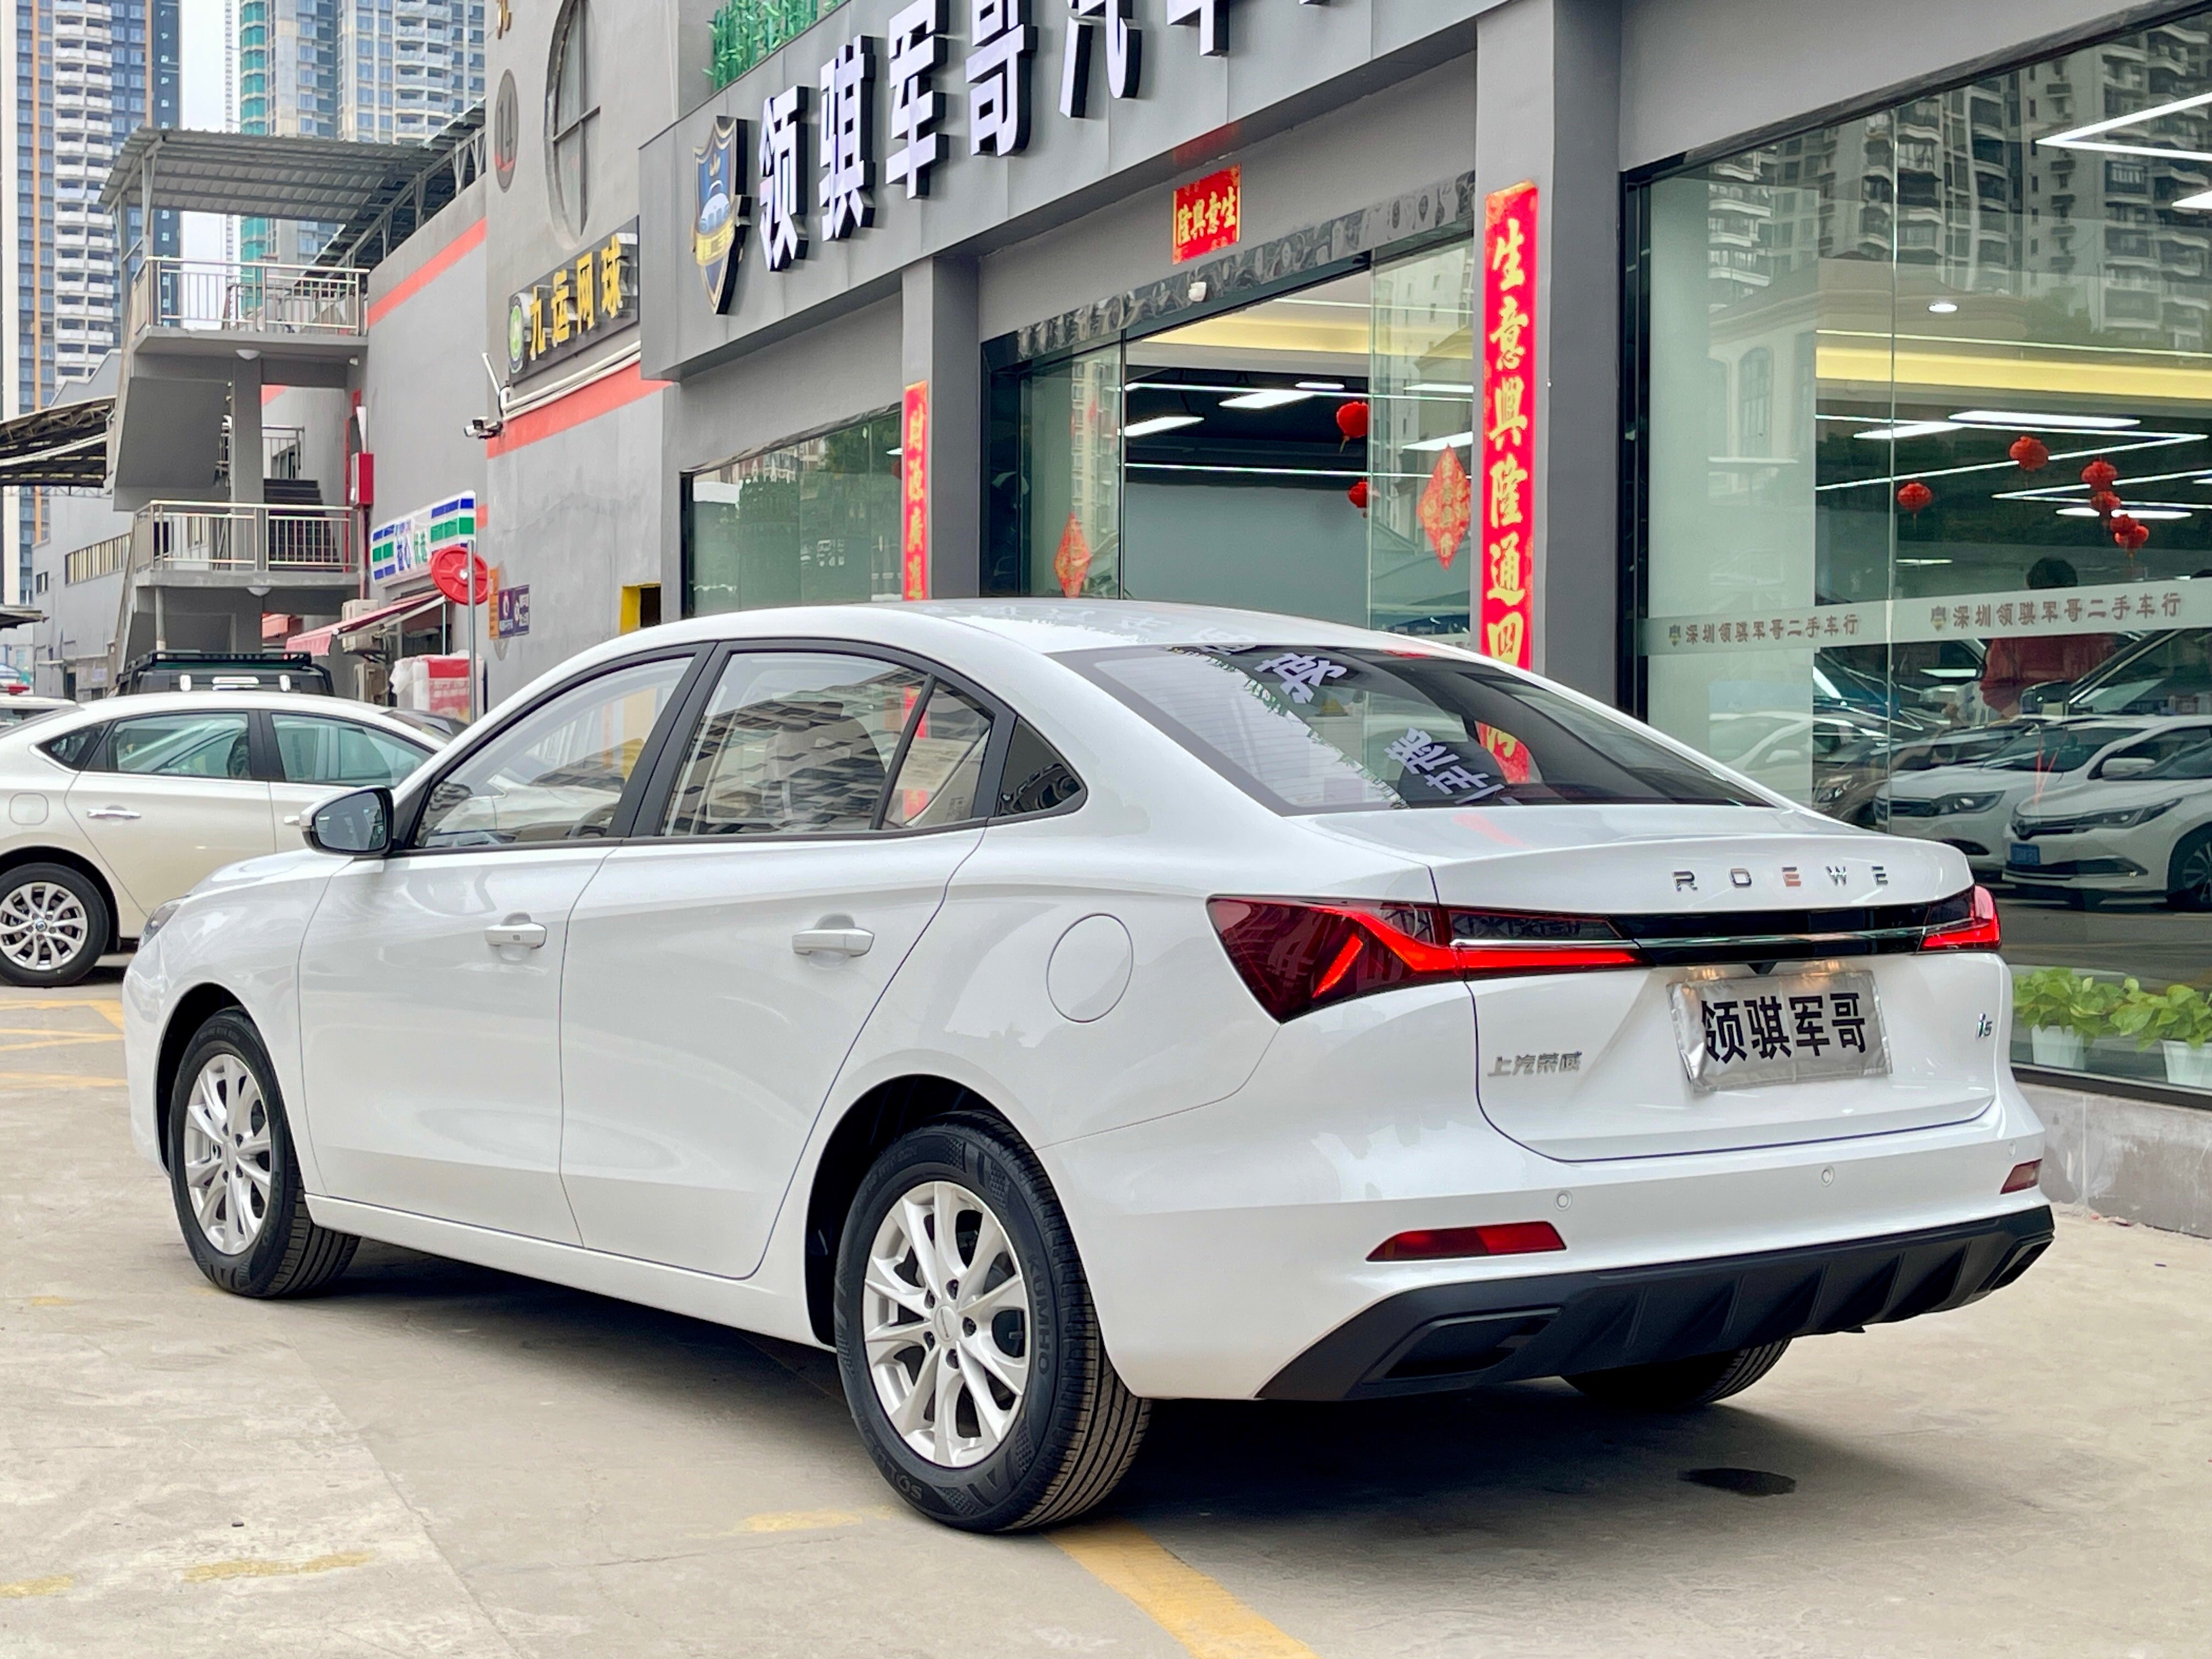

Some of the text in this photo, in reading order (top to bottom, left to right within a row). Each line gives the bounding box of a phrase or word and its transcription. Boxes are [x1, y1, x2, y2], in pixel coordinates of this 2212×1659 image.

[758, 0, 1229, 271] 领骐军哥
[1671, 865, 1888, 891] ROEWE
[1701, 992, 1866, 1064] 领骐军哥
[1977, 1012, 1992, 1037] i5
[1487, 1051, 1582, 1076] 上汽荣威
[1026, 1253, 1050, 1375] KUMHO
